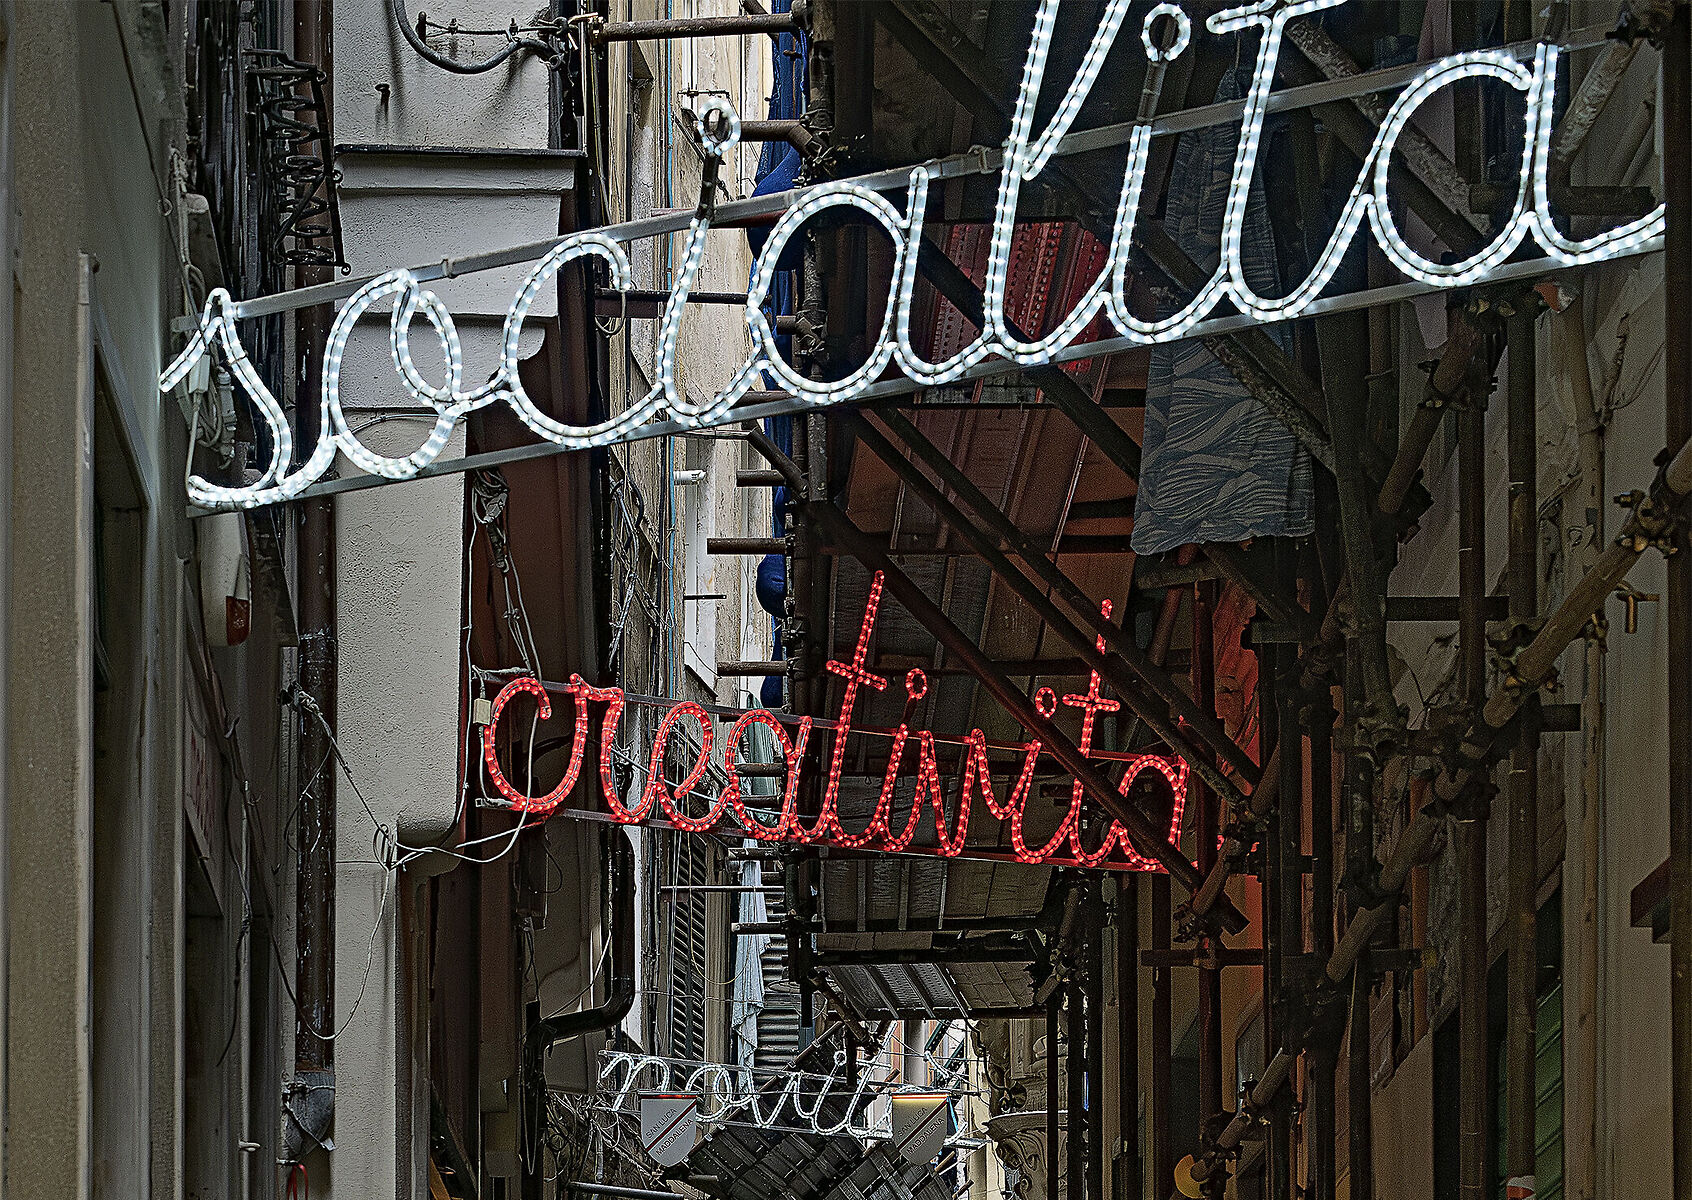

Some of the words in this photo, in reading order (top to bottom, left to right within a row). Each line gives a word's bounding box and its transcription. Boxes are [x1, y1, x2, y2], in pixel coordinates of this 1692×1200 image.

[645, 1122, 660, 1139] SAN
[659, 1108, 677, 1126] LUCA
[655, 1118, 693, 1156] MADDALENA
[898, 1122, 912, 1137] SAN
[910, 1107, 928, 1124] LUCA
[906, 1117, 944, 1155] MADDALENA
